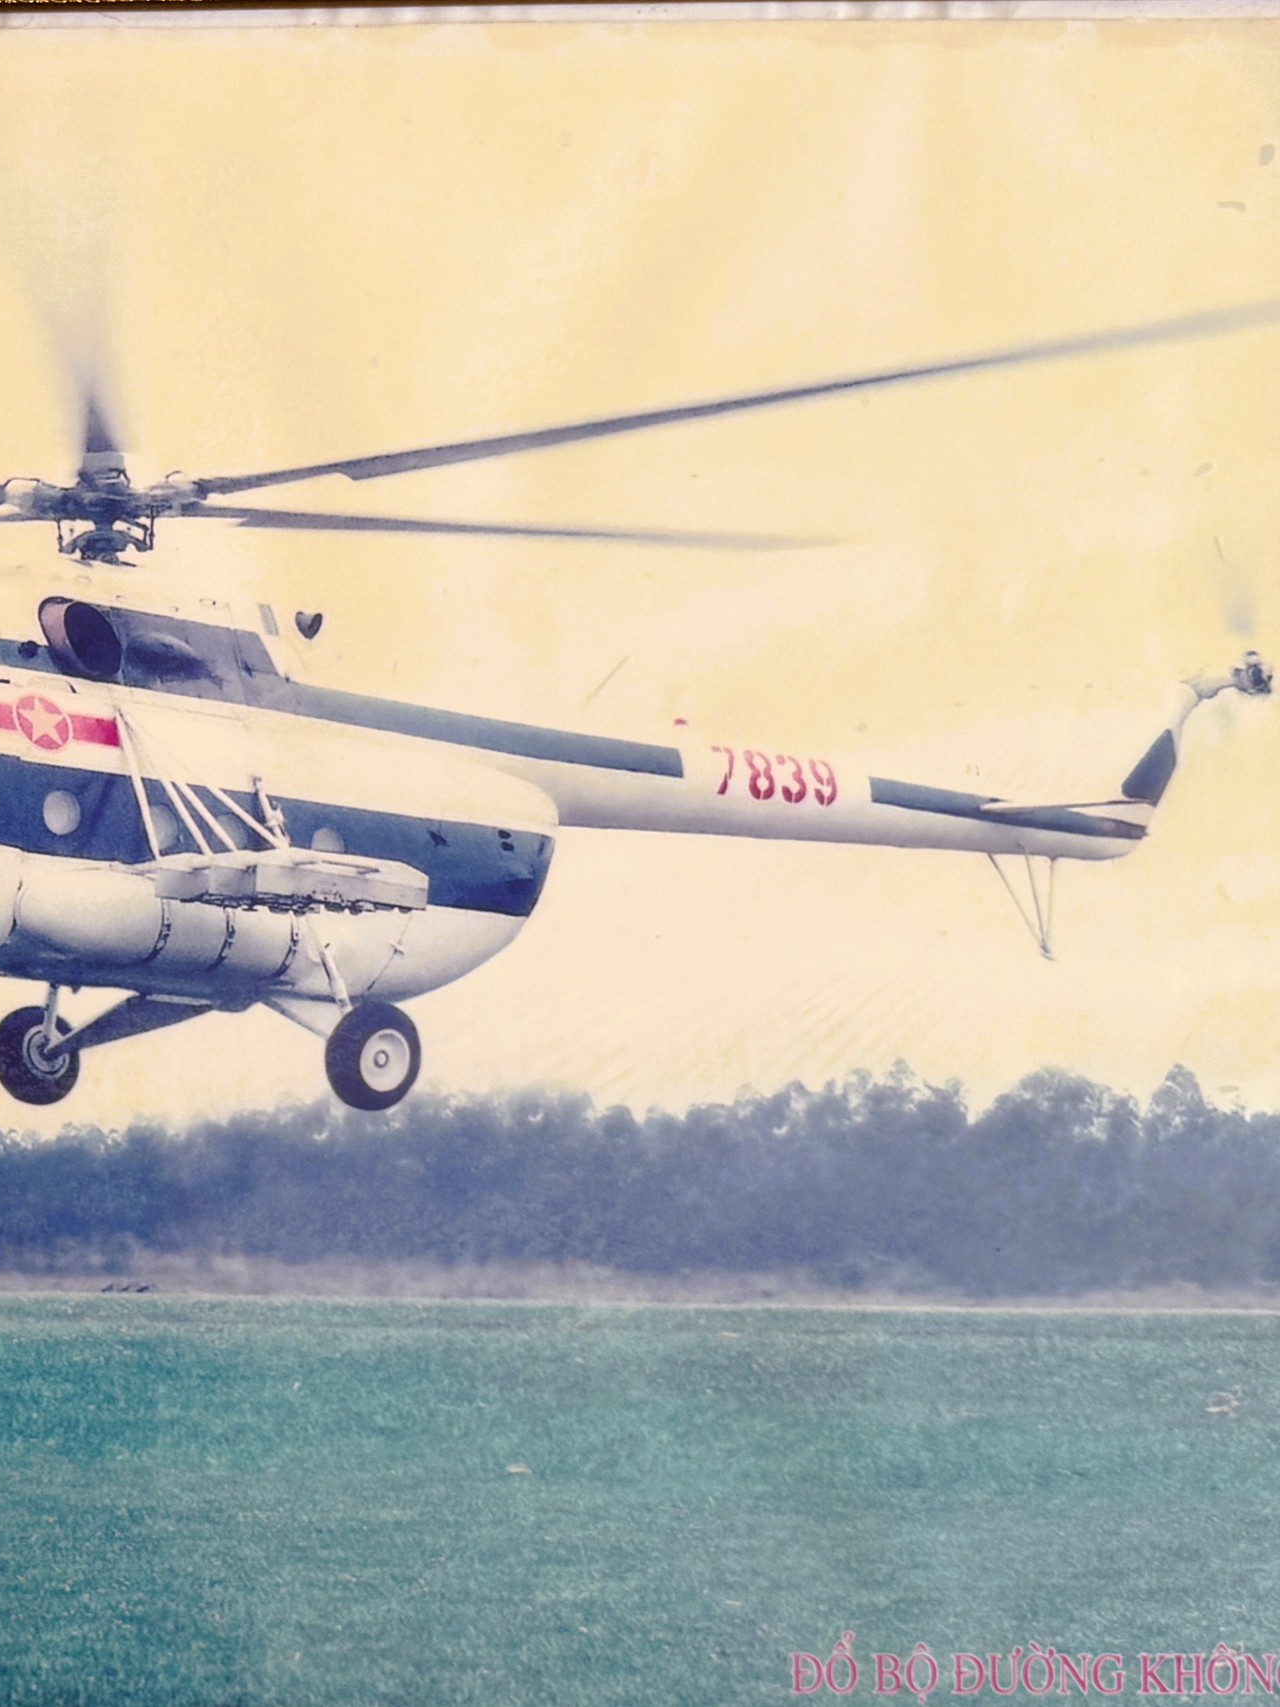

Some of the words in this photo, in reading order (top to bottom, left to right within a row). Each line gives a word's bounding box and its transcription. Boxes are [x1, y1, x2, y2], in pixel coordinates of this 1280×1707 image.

[711, 745, 837, 806] 7839
[790, 1631, 859, 1695] ĐỔ
[873, 1642, 940, 1705] BỘ
[951, 1641, 1125, 1696] ĐƯỜNG
[1137, 1642, 1280, 1696] KHÔN
